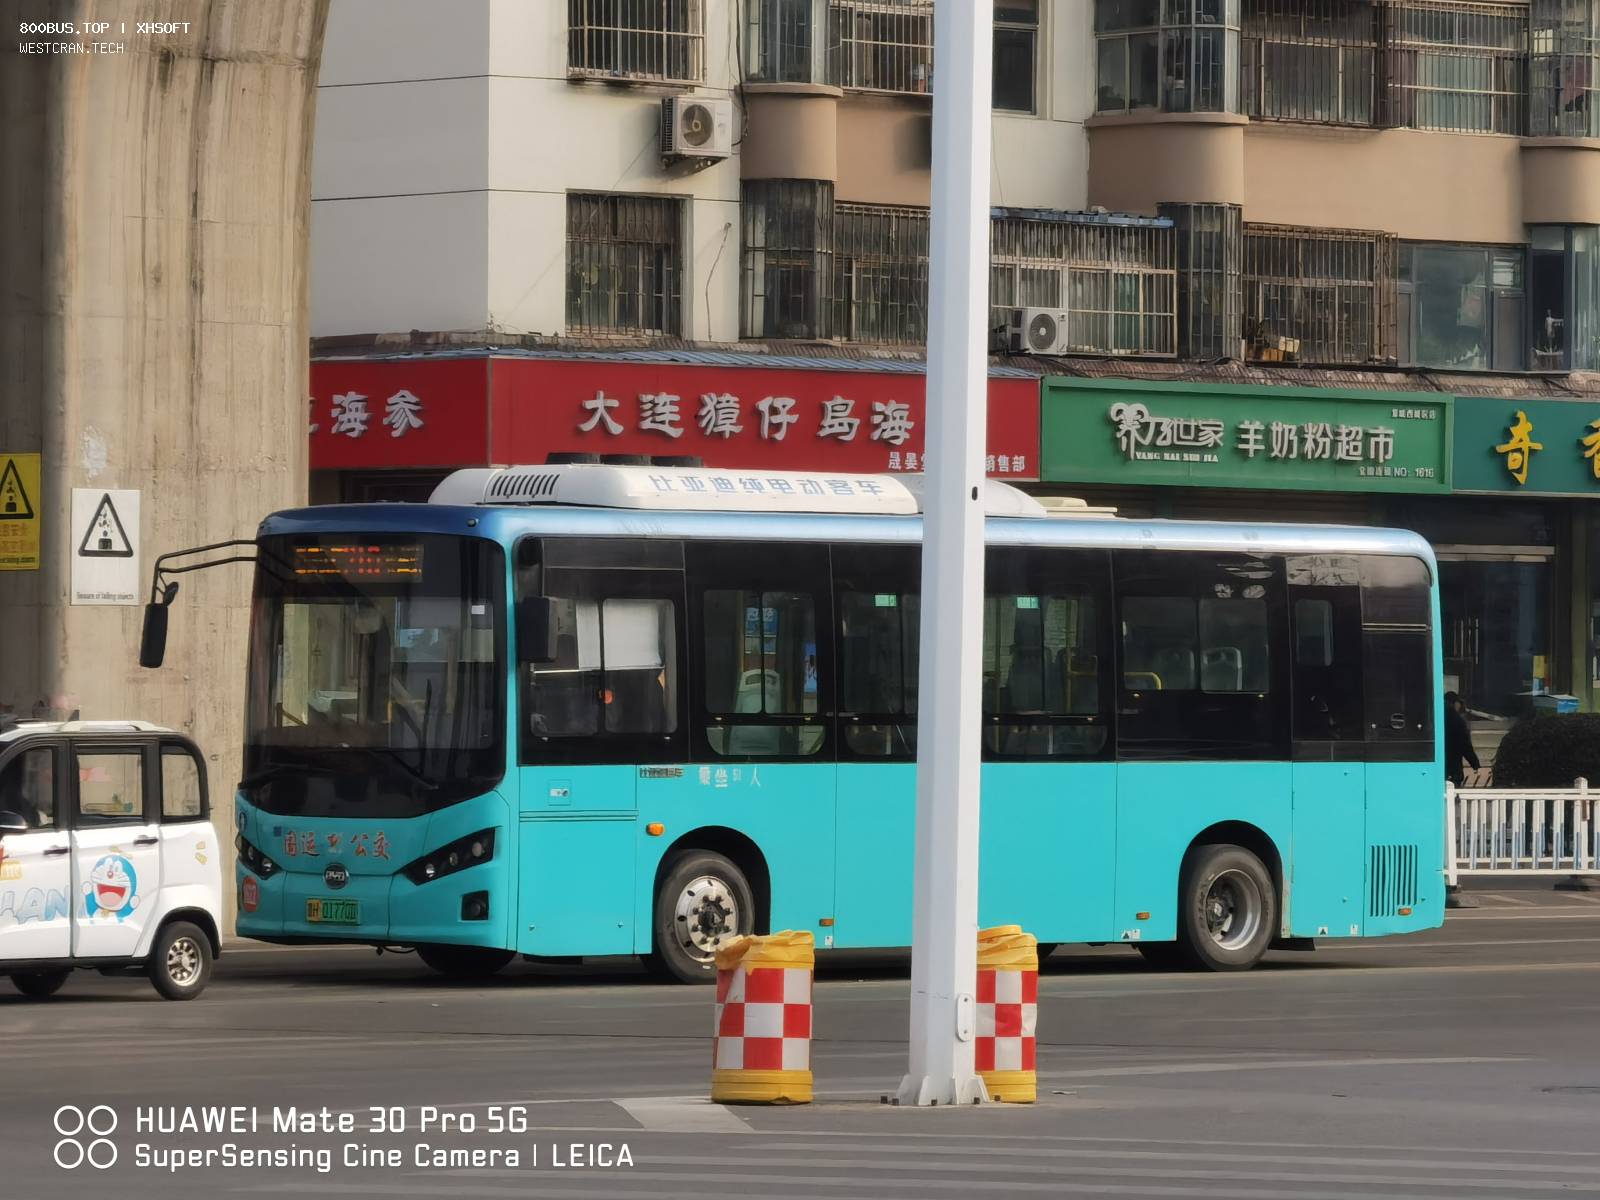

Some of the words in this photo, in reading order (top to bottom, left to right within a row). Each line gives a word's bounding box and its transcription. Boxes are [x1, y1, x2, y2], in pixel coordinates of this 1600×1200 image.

[309, 390, 424, 438] 海参
[1237, 418, 1395, 464] 羊奶粉超市
[648, 474, 885, 496] 比亚迪纯电动客车
